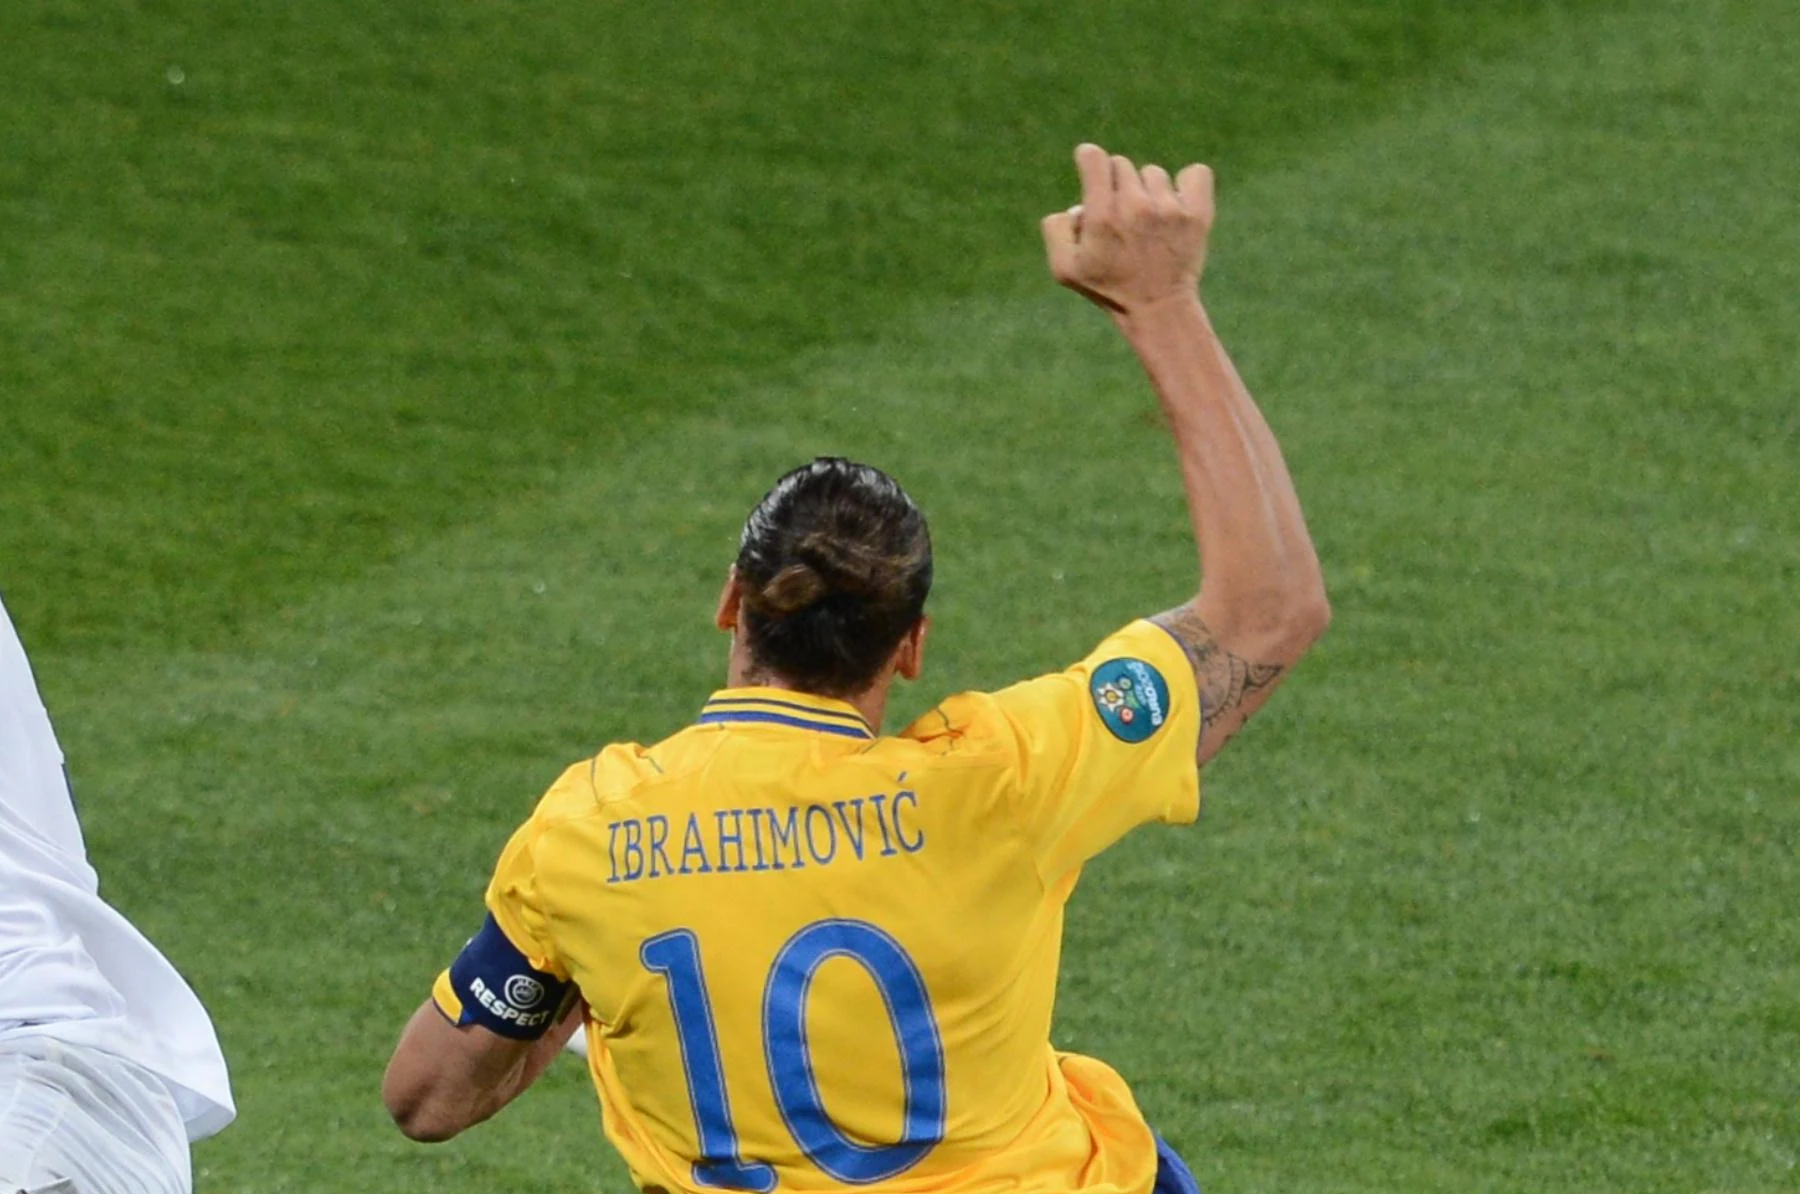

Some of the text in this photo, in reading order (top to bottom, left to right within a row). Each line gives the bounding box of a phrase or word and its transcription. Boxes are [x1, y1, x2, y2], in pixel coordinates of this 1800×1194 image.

[606, 771, 924, 883] IBRAHIMOVIĆ
[469, 976, 550, 1027] RESPECT
[638, 917, 947, 1194] 10
